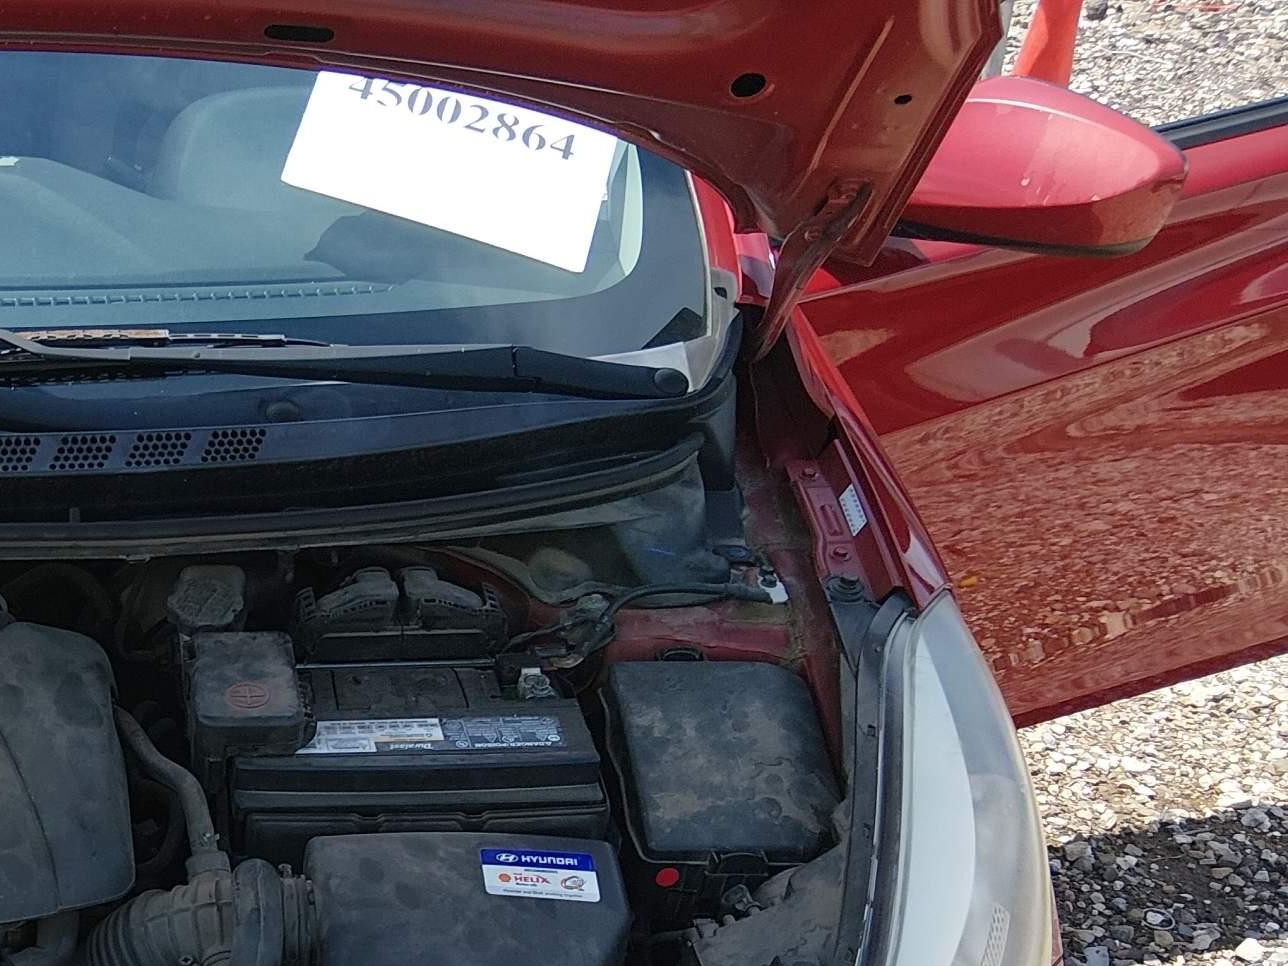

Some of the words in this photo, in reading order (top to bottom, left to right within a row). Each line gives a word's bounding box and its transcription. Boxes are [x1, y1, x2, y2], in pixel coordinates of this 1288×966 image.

[348, 76, 576, 161] 45002864
[521, 854, 578, 866] HYUNDAI
[513, 874, 551, 885] HELIX
